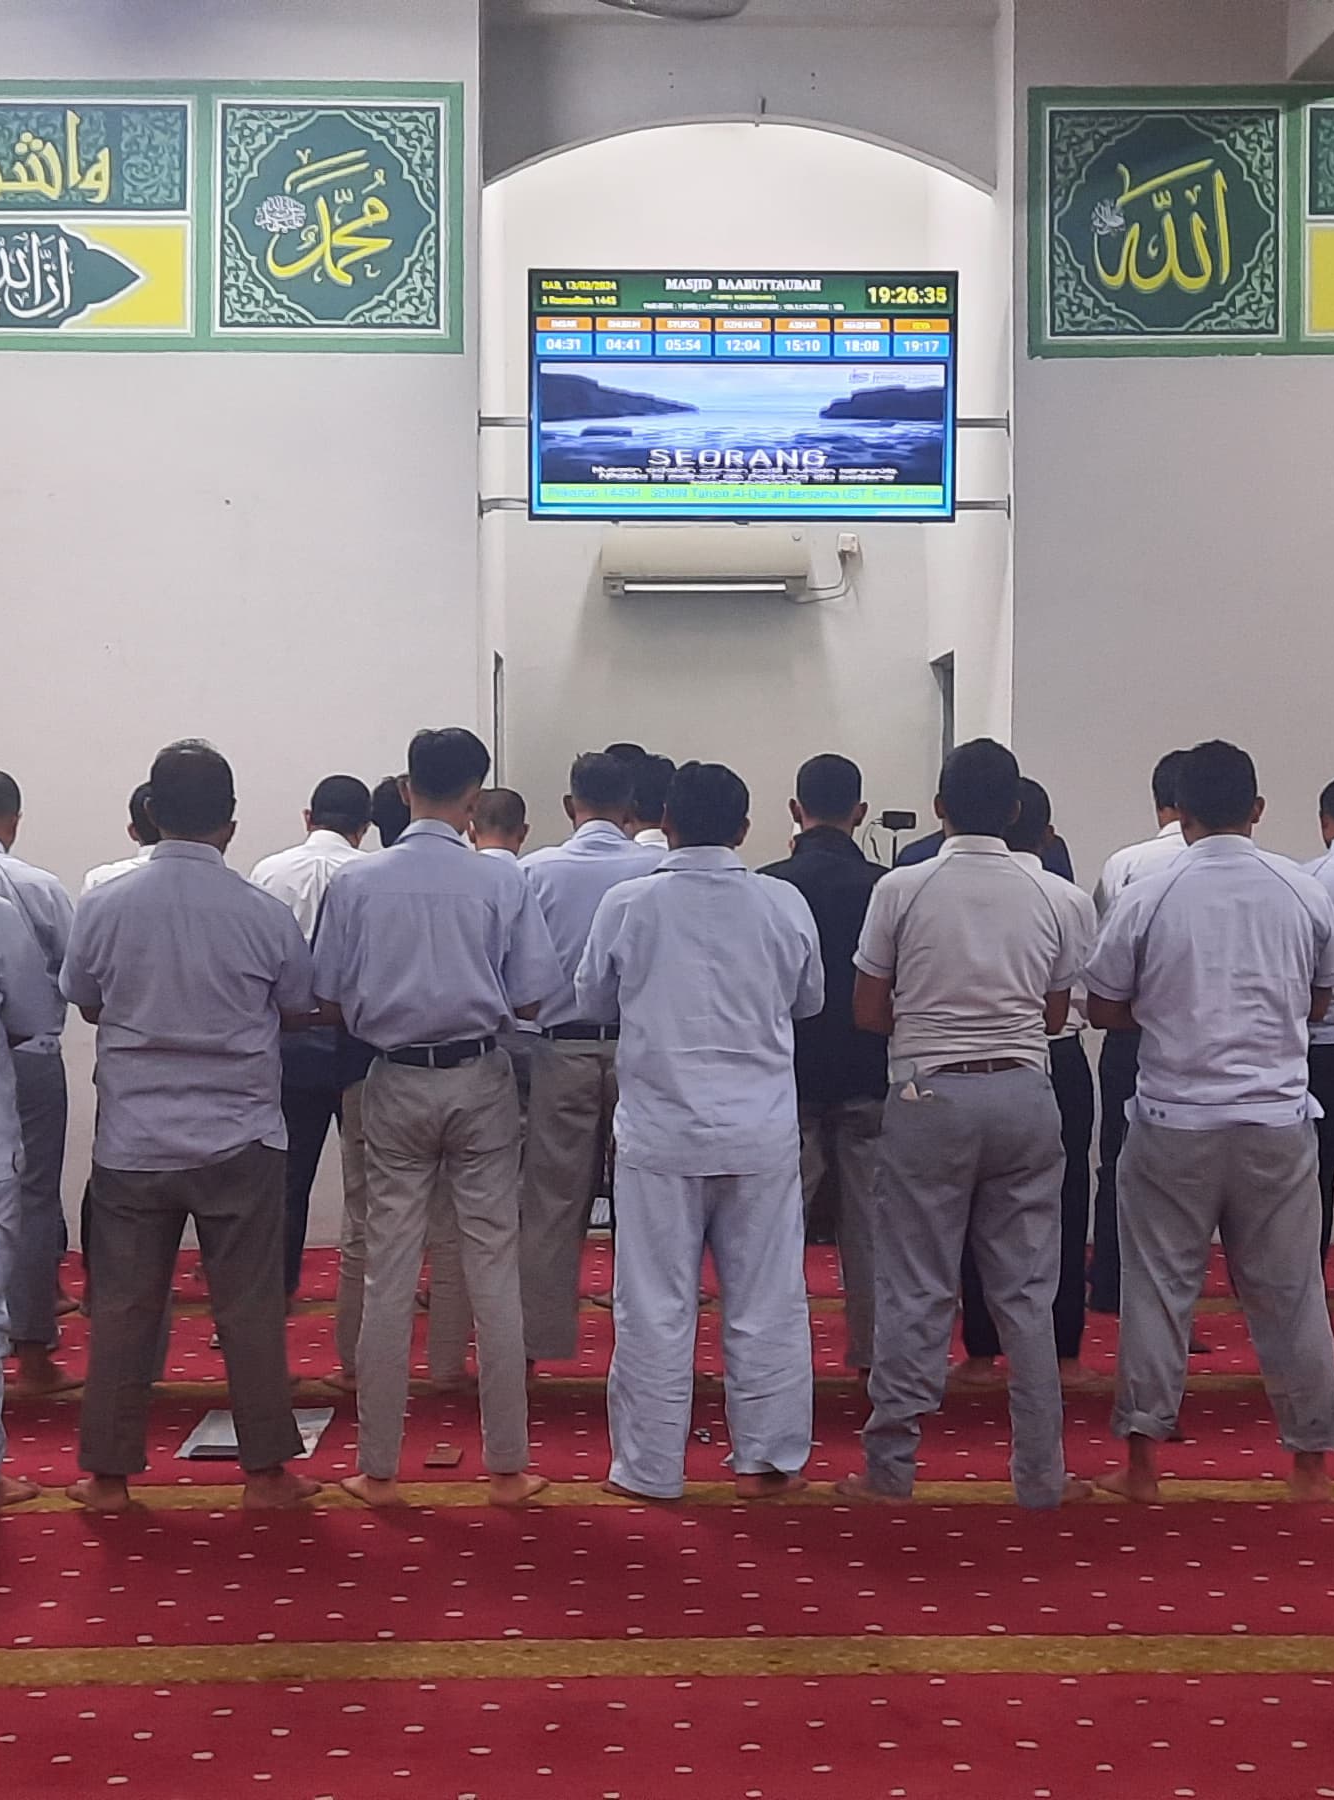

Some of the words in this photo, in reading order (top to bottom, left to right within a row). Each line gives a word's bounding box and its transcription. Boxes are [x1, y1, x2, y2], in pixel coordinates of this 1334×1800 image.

[665, 278, 713, 293] MASJID
[867, 286, 947, 304] 19:26:35
[546, 338, 582, 350] 04:31
[605, 338, 641, 350] 04:41
[665, 339, 702, 351] 05:54
[725, 339, 761, 351] 12:04
[785, 339, 821, 351] 15:10
[903, 340, 940, 352] 19:17
[648, 449, 828, 466] SEORANG
